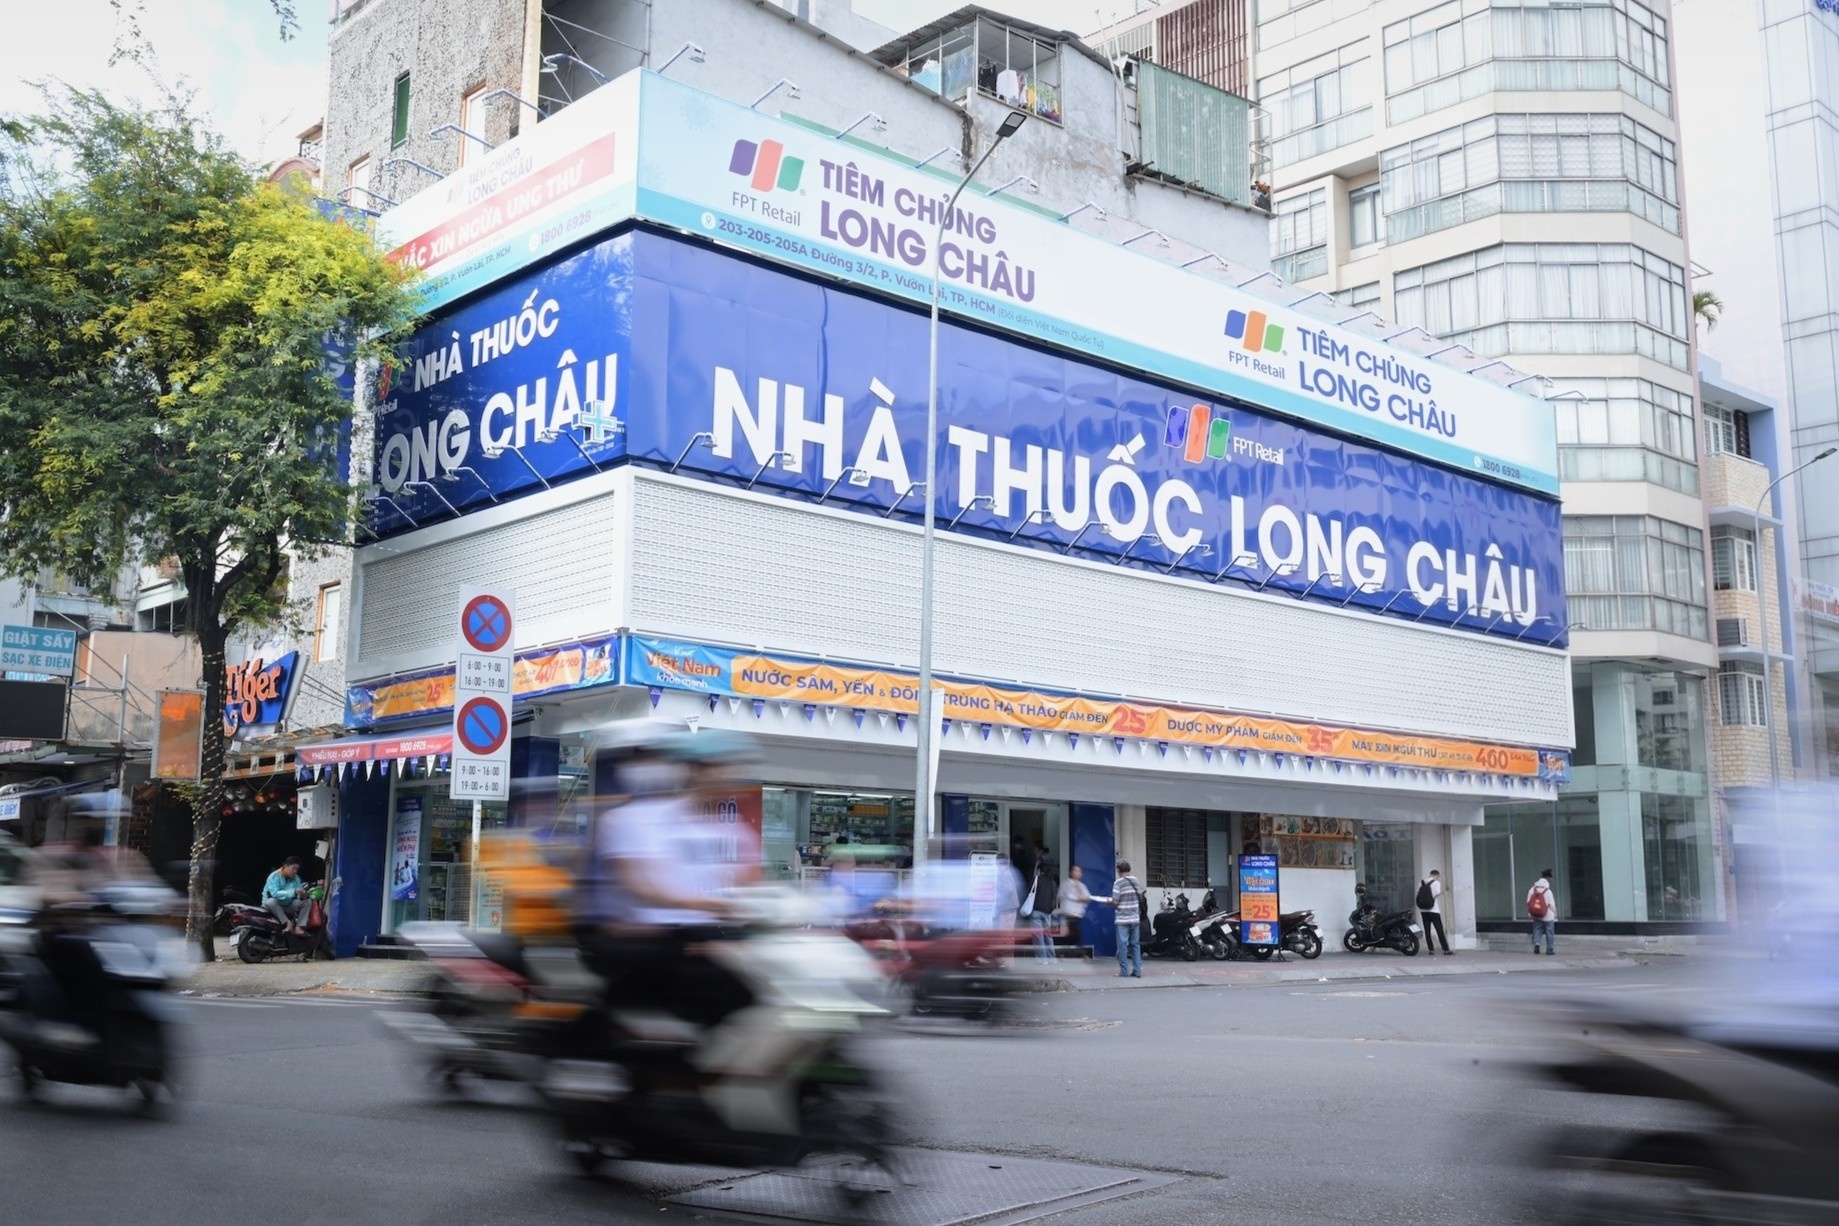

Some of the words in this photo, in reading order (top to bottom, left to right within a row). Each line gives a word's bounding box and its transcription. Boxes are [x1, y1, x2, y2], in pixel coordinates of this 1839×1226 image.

[732, 191, 758, 212] FPT
[762, 200, 801, 227] Retail
[819, 158, 885, 207] TIÊM
[894, 188, 996, 244] CHỦNG
[429, 226, 454, 262] XIN
[541, 223, 564, 245] 1800
[566, 210, 592, 231] 6928
[820, 200, 927, 266] LONG
[938, 241, 1036, 302] CHÂU
[718, 218, 808, 257] 203-205-205A
[811, 247, 853, 273] Đường
[856, 261, 878, 280] 3/2,
[881, 269, 892, 283] P.
[894, 273, 925, 294] Vườn
[950, 290, 968, 306] TP.
[970, 299, 996, 315] HCM
[1052, 324, 1070, 338] Nam
[414, 330, 463, 392] NHÀ
[470, 288, 560, 367] THUỐC
[1228, 350, 1250, 367] FPT
[1253, 358, 1286, 380] Retail
[1297, 326, 1350, 367] TIÊM
[1355, 349, 1432, 395] CHỦNG
[1299, 360, 1380, 412] LONG
[1387, 394, 1457, 438] CHÂU
[364, 409, 470, 500] ONG
[480, 349, 618, 458] CHÂU
[1233, 436, 1254, 457] FPT
[1482, 459, 1500, 474] 1800
[1502, 465, 1520, 480] 6928
[711, 366, 914, 497] NHÀ
[948, 424, 1204, 555] THUỐC
[1231, 495, 1388, 594] LONG
[1406, 540, 1537, 627] CHÂU
[4, 630, 39, 647] GIẶT
[42, 632, 73, 649] SẤY
[2, 652, 25, 666] SẠC
[28, 654, 42, 666] XE
[45, 654, 71, 671] ĐIỆN
[467, 661, 481, 671] 6:00
[488, 662, 501, 672] 9:00
[682, 657, 721, 676] Nam
[226, 658, 282, 723] Tiger
[465, 676, 482, 686] 16:00
[488, 678, 504, 688] 19:00
[742, 668, 792, 687] NƯỚC
[796, 673, 838, 694] SÂM,
[843, 678, 874, 696] YẾN
[879, 688, 886, 697] &
[994, 700, 1015, 715] HẠ
[1018, 702, 1058, 718] THẢO
[1087, 711, 1109, 724] ĐẾN
[1168, 719, 1203, 735] DƯỢC
[1205, 720, 1223, 735] MỸ
[461, 781, 478, 791] 19:00
[485, 782, 499, 791] 6:00
[462, 765, 476, 775] 9:00
[483, 766, 500, 776] 16:00
